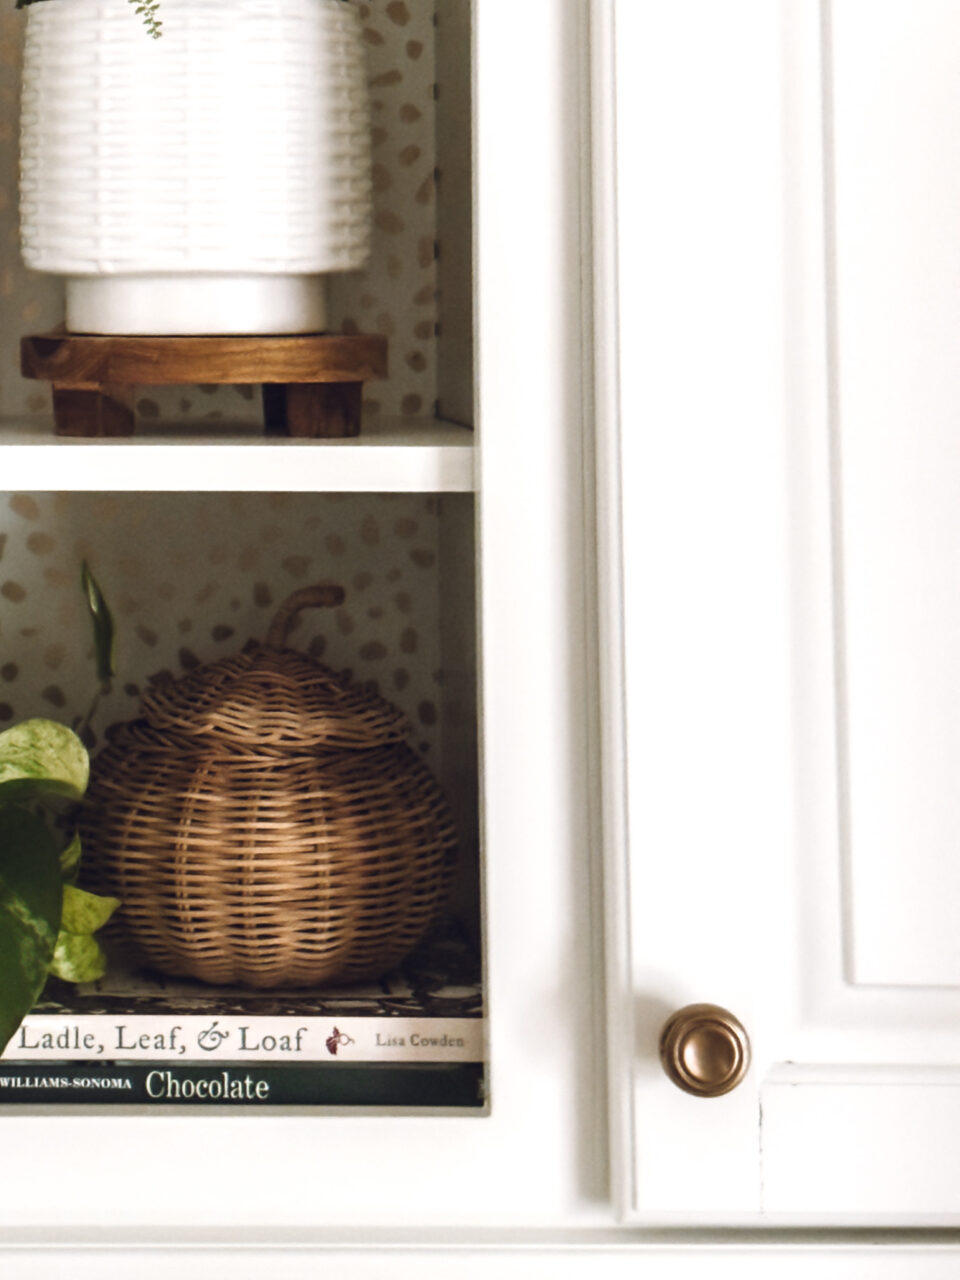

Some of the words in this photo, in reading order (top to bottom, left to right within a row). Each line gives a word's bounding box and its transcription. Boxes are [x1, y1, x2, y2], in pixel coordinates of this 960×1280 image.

[17, 1026, 105, 1055] Ladle,
[114, 1025, 187, 1055] Leaf,
[196, 1021, 230, 1052] &
[238, 1025, 309, 1053] Loaf
[375, 1033, 408, 1048] Lisa
[410, 1033, 466, 1049] Cowden
[144, 1070, 271, 1100] Chocolate
